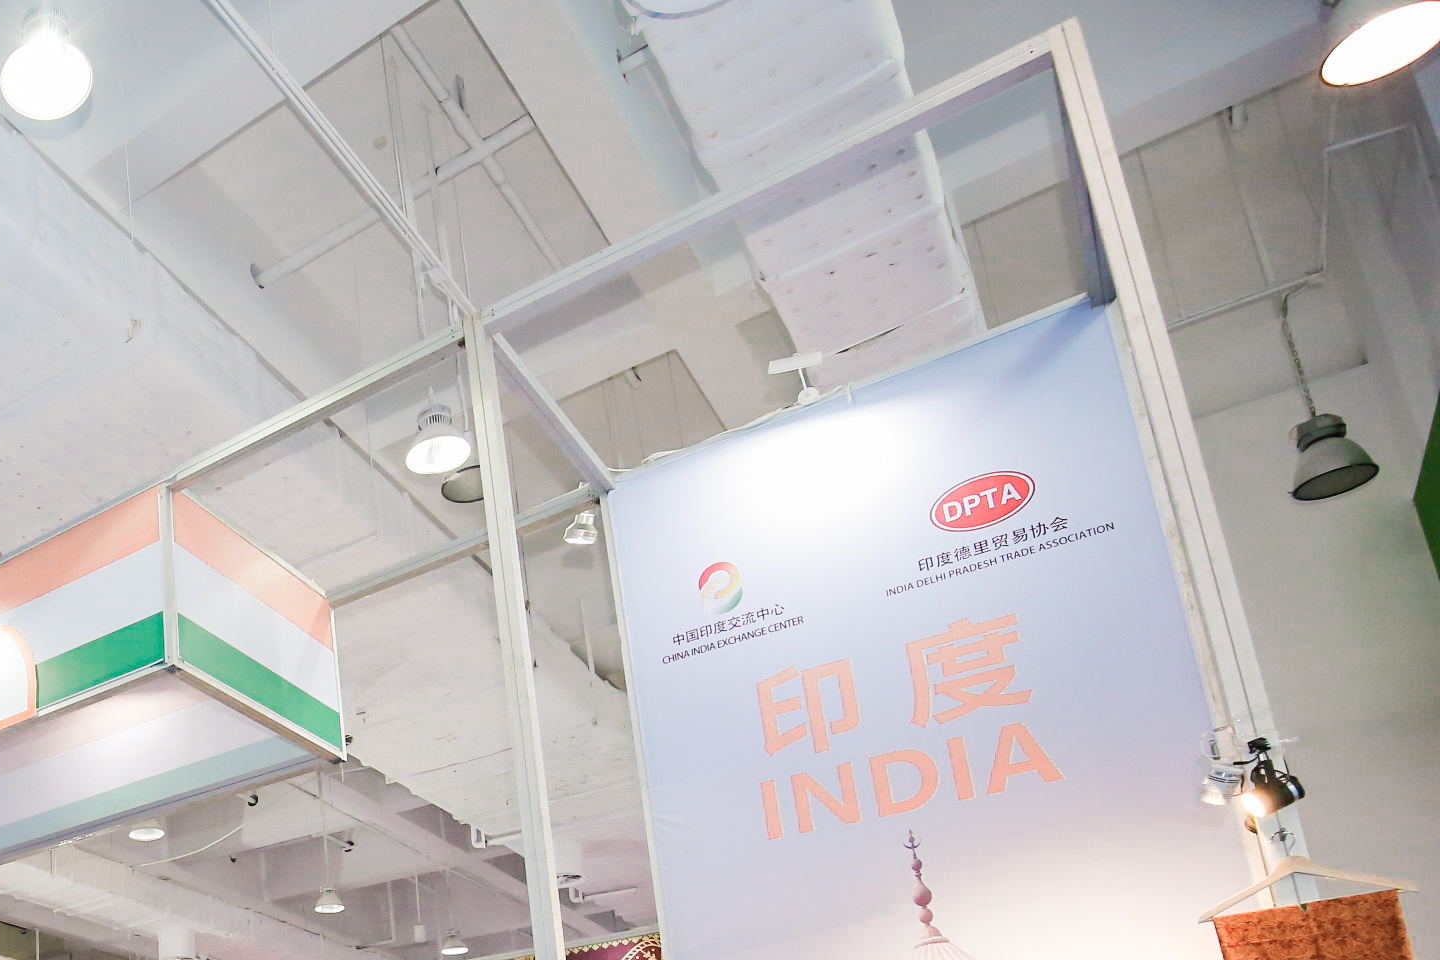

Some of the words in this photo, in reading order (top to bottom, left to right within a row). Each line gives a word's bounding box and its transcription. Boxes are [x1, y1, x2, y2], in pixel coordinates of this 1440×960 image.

[942, 481, 1023, 525] DPTA
[885, 582, 915, 597] INDIA
[916, 572, 947, 588] DELHI
[948, 558, 998, 578] PRADESH
[1000, 546, 1036, 563] TRADE
[1038, 521, 1116, 551] ASSOCIATION
[918, 516, 1069, 572] 印度德里贸易协会
[662, 650, 690, 664] CHINA
[691, 642, 716, 656] INDIA
[717, 627, 767, 649] EXCHANGE
[768, 615, 805, 633] CENTER
[672, 603, 785, 646] 中国印度交流中心
[755, 613, 1034, 756] 印度
[759, 721, 1067, 840] INDIA
